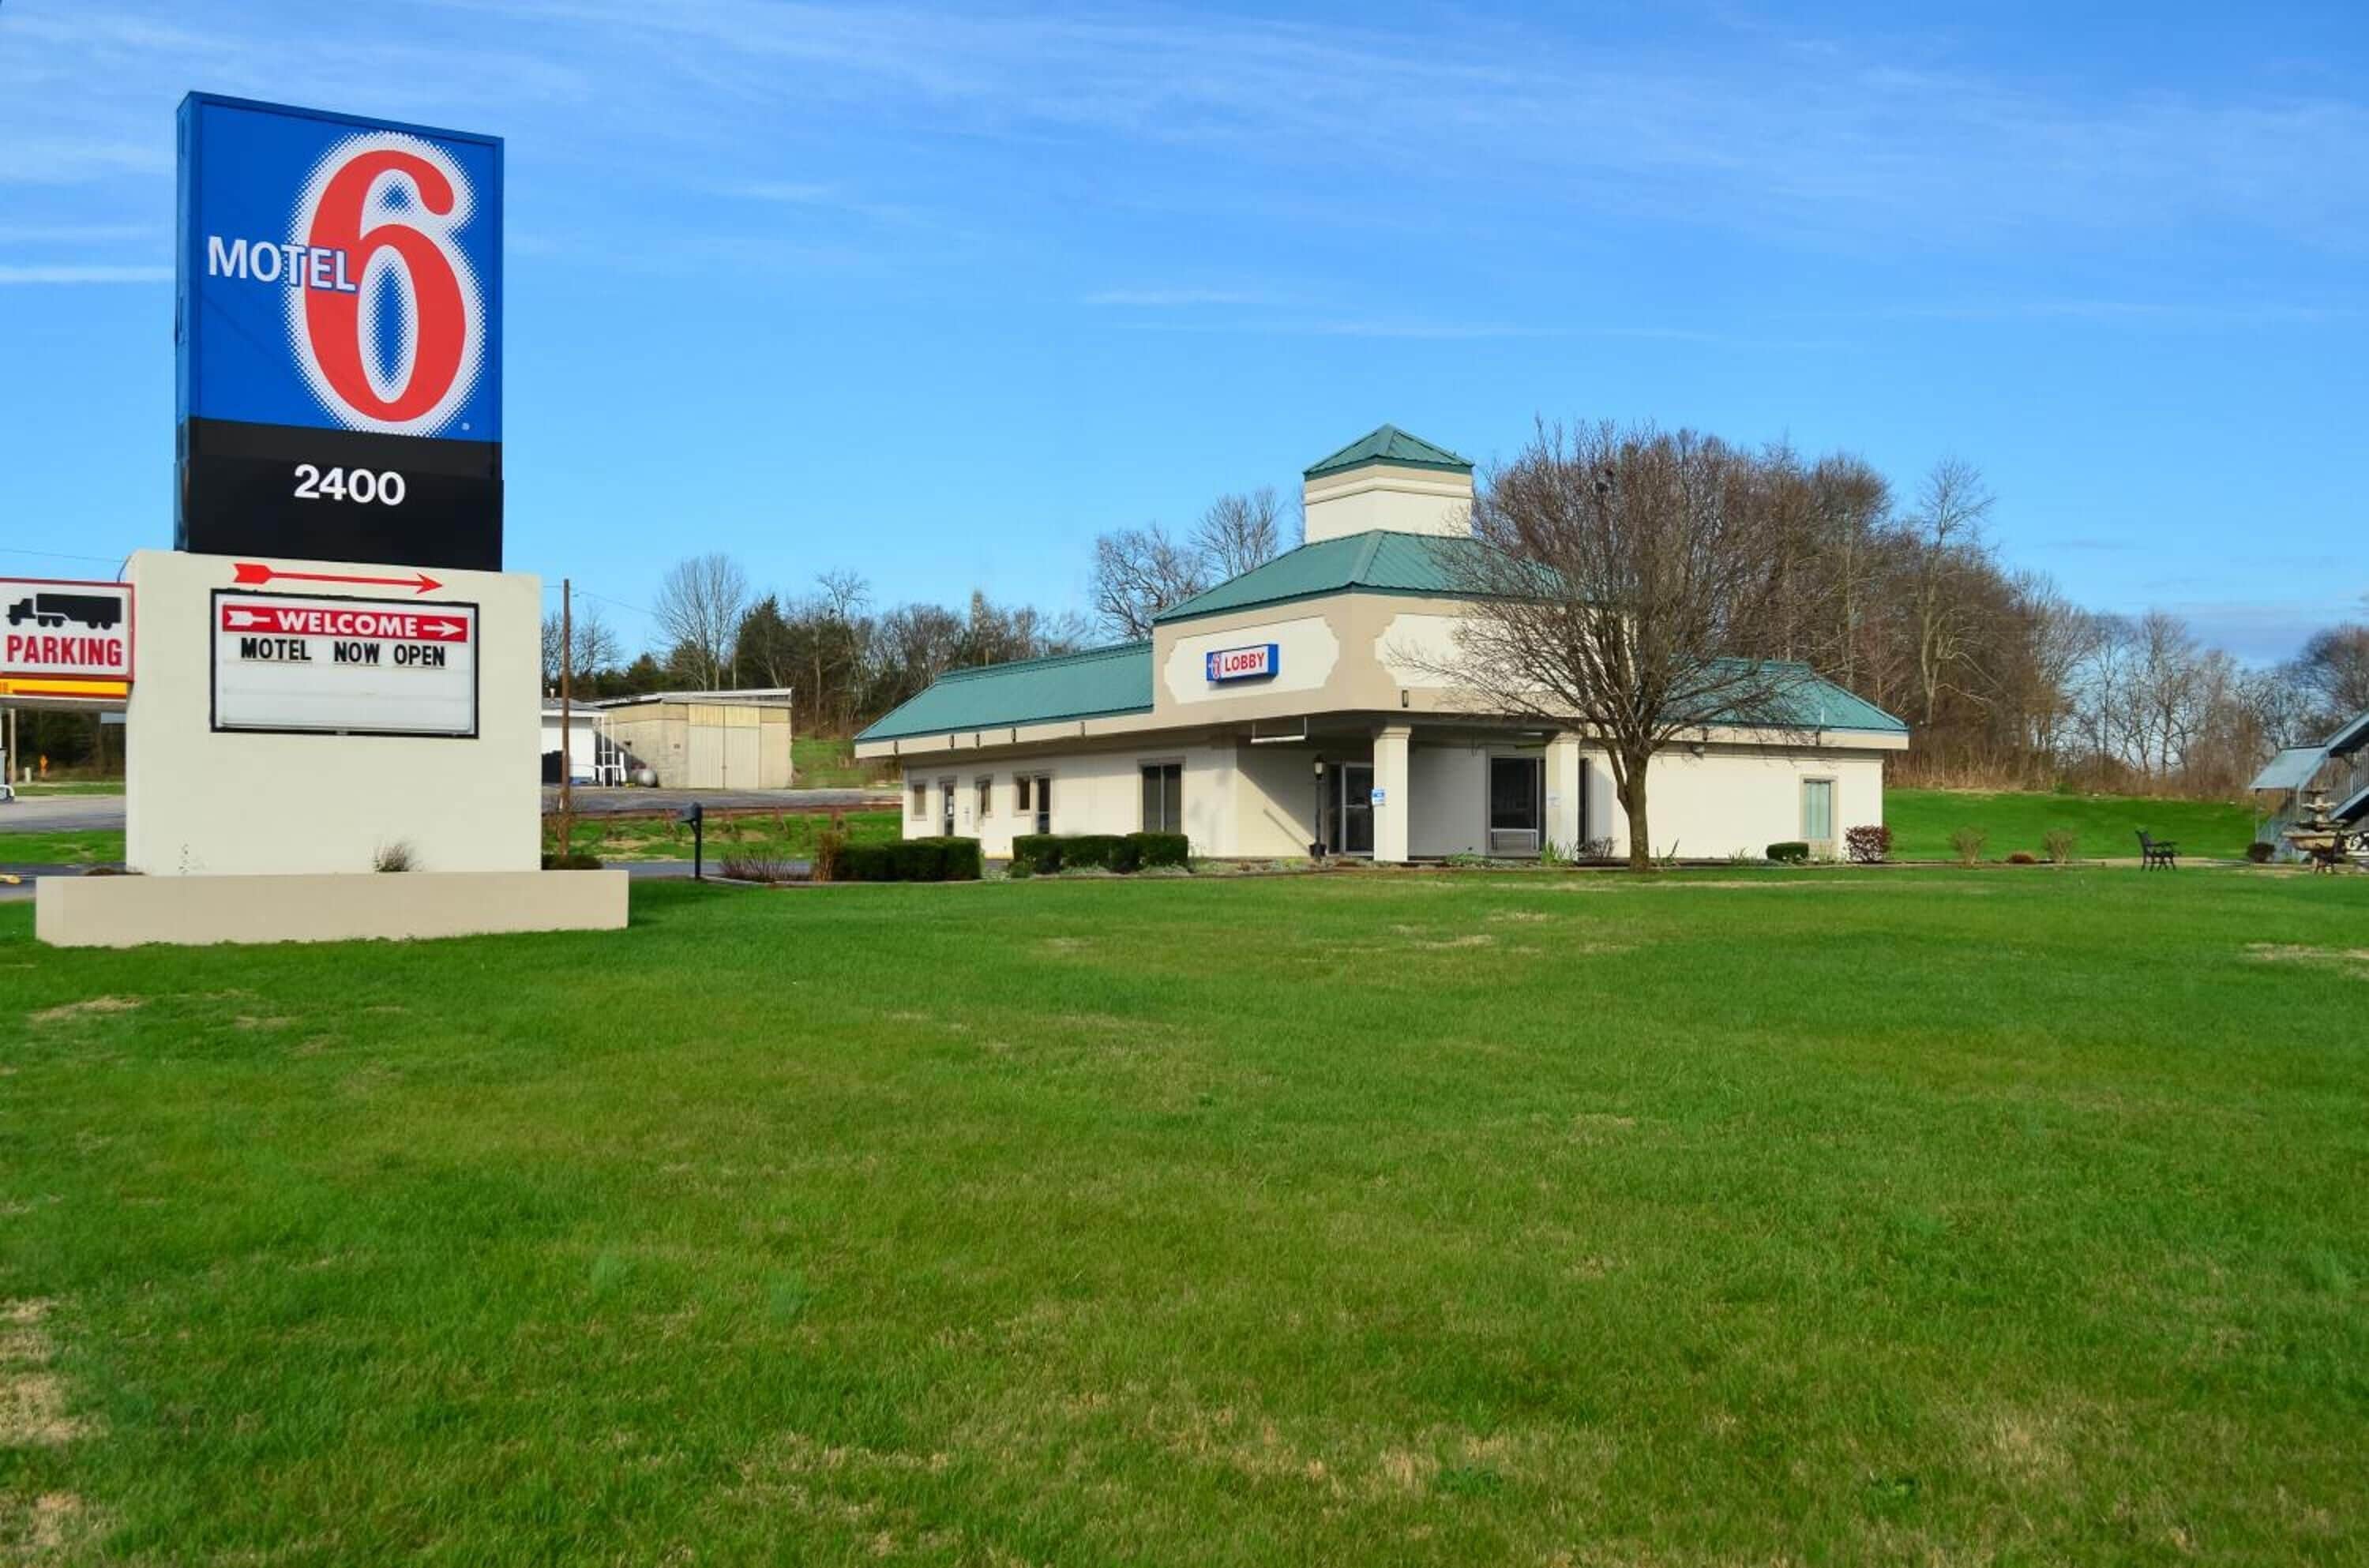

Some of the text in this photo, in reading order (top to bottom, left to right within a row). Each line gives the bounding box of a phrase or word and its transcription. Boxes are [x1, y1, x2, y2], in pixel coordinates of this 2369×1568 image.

[208, 145, 468, 424] MOTEL 6
[294, 463, 405, 505] 2400
[276, 610, 418, 637] WELCOME
[6, 634, 122, 666] PARKING
[241, 637, 446, 666] MOTEL NOW OPEN
[1225, 653, 1264, 672] LOBBY
